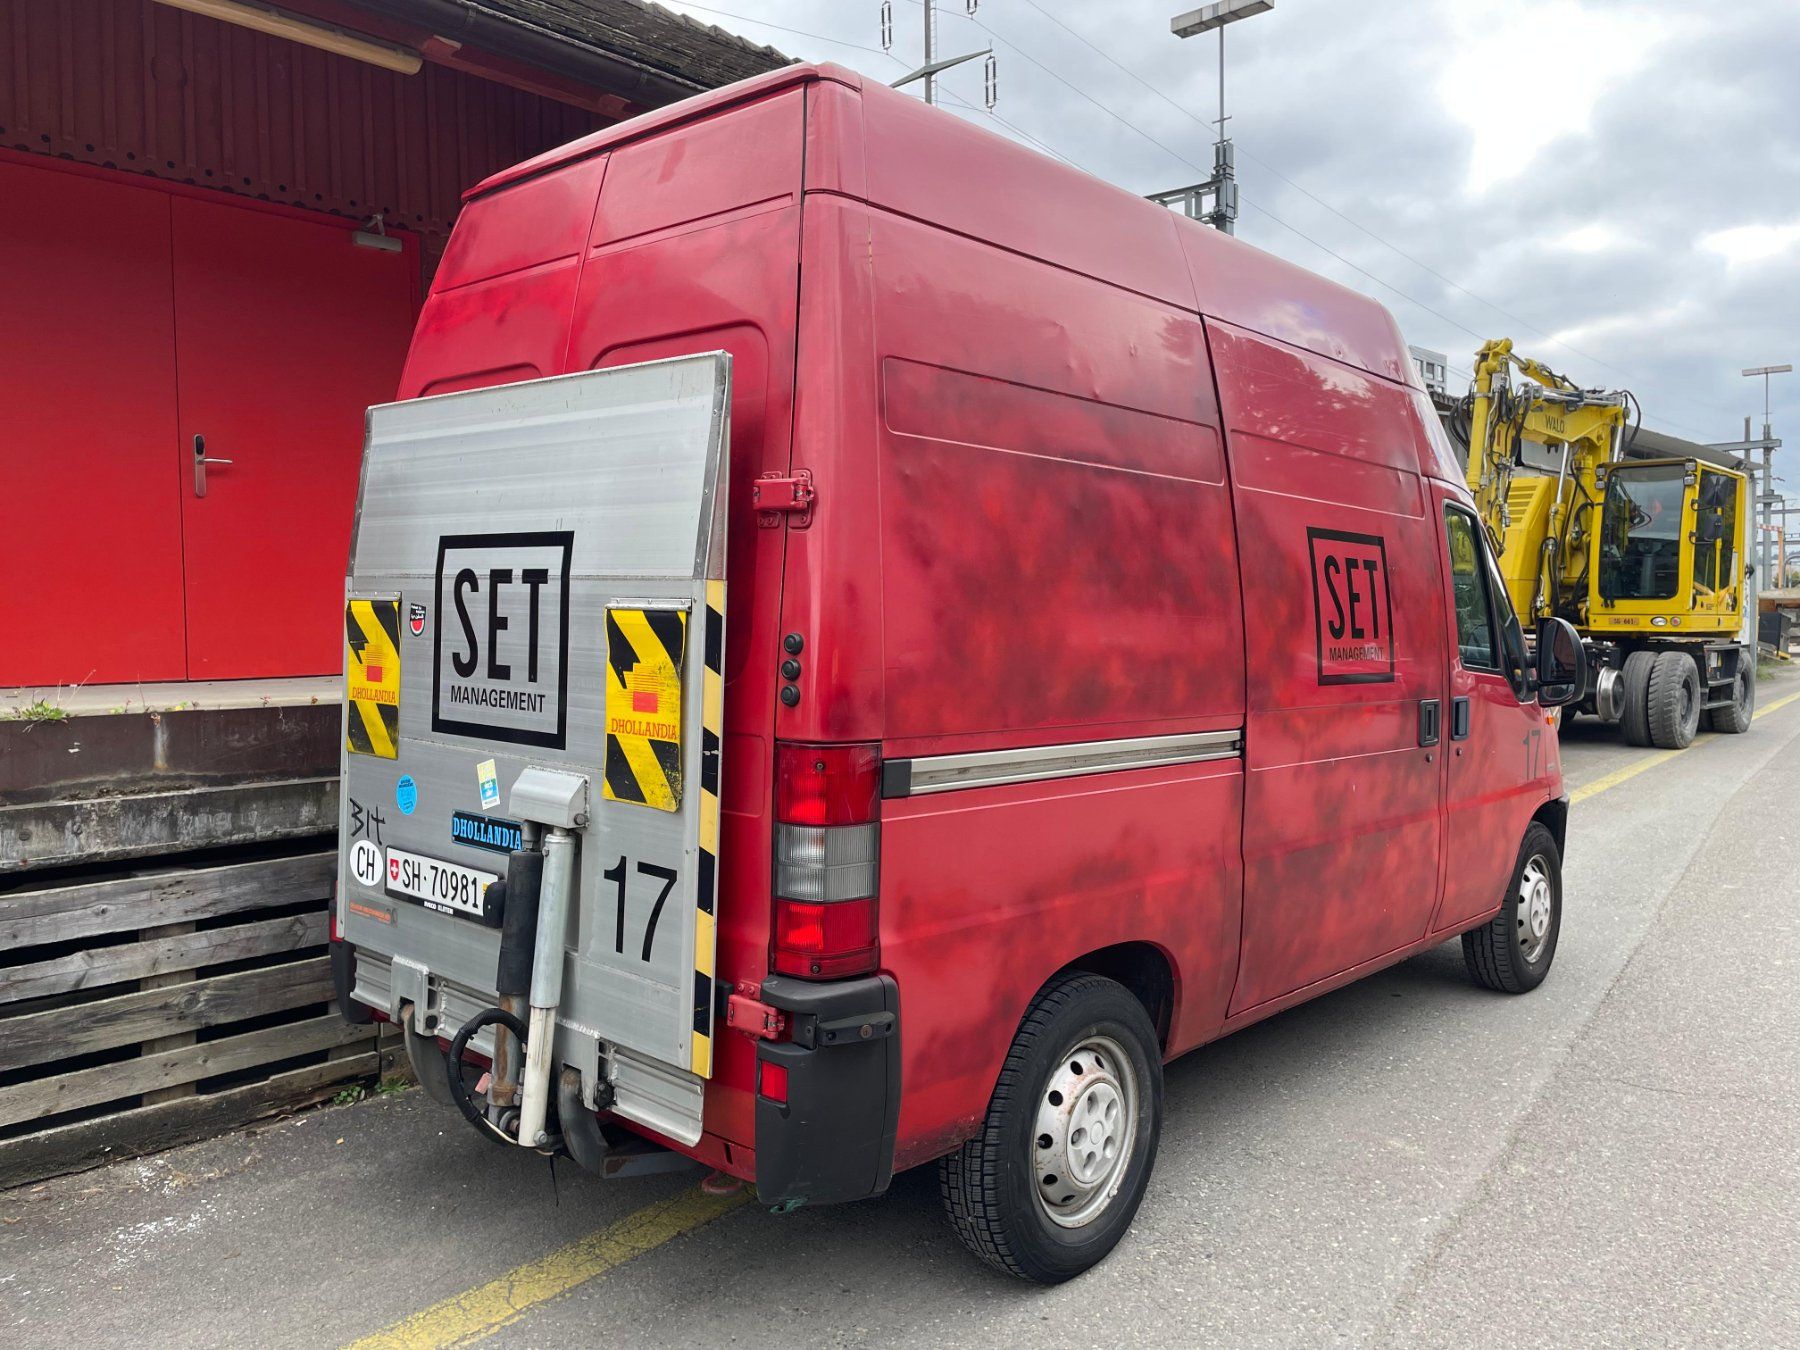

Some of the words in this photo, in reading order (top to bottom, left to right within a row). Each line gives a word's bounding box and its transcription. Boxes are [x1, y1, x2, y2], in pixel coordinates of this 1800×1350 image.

[1324, 555, 1379, 640] SET
[452, 568, 549, 683] SET
[1329, 646, 1384, 661] MANAGEMENT
[352, 687, 396, 703] DHOLLANDIA
[450, 685, 546, 713] MANAGEMENT
[611, 718, 677, 739] DHOLLANDIA
[1523, 730, 1541, 781] 17
[453, 817, 521, 850] DHOLLANDIA
[357, 845, 375, 881] CH
[604, 855, 678, 963] 17
